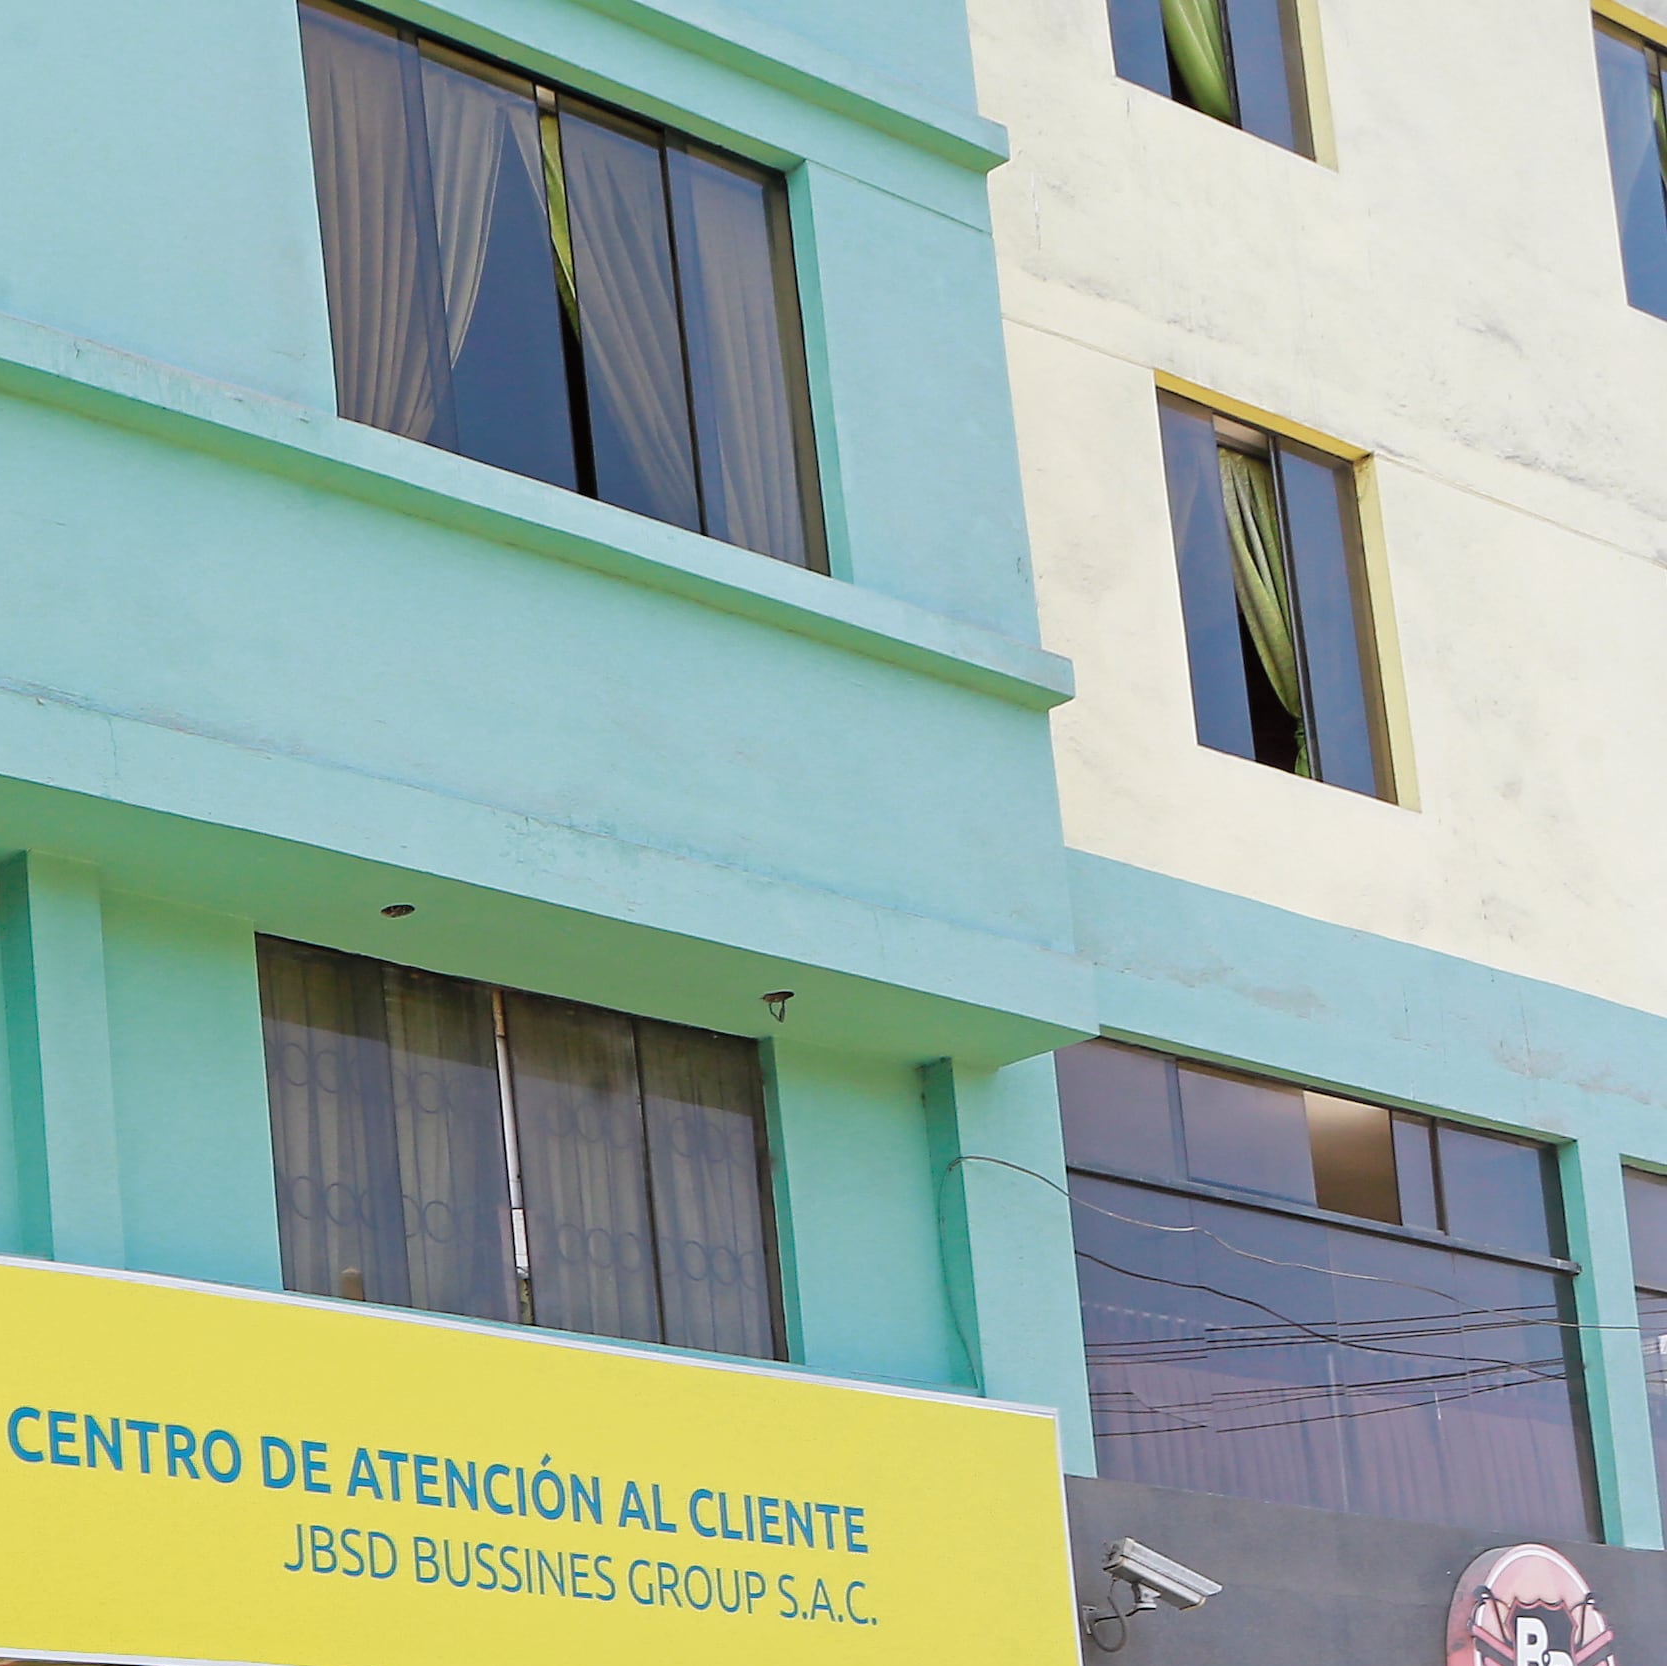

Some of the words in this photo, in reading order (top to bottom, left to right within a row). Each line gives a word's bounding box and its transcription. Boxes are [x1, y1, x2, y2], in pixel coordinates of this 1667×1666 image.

[7, 1406, 242, 1484] CENTRO
[261, 1435, 330, 1495] DE
[347, 1446, 604, 1527] ATENCIÓN
[617, 1480, 678, 1533] AL
[688, 1486, 869, 1554] CLIENTE
[283, 1523, 398, 1579] JBSD
[413, 1535, 616, 1602] BUSSINES
[628, 1557, 767, 1616] GROUP
[779, 1572, 880, 1627] S.A.C.
